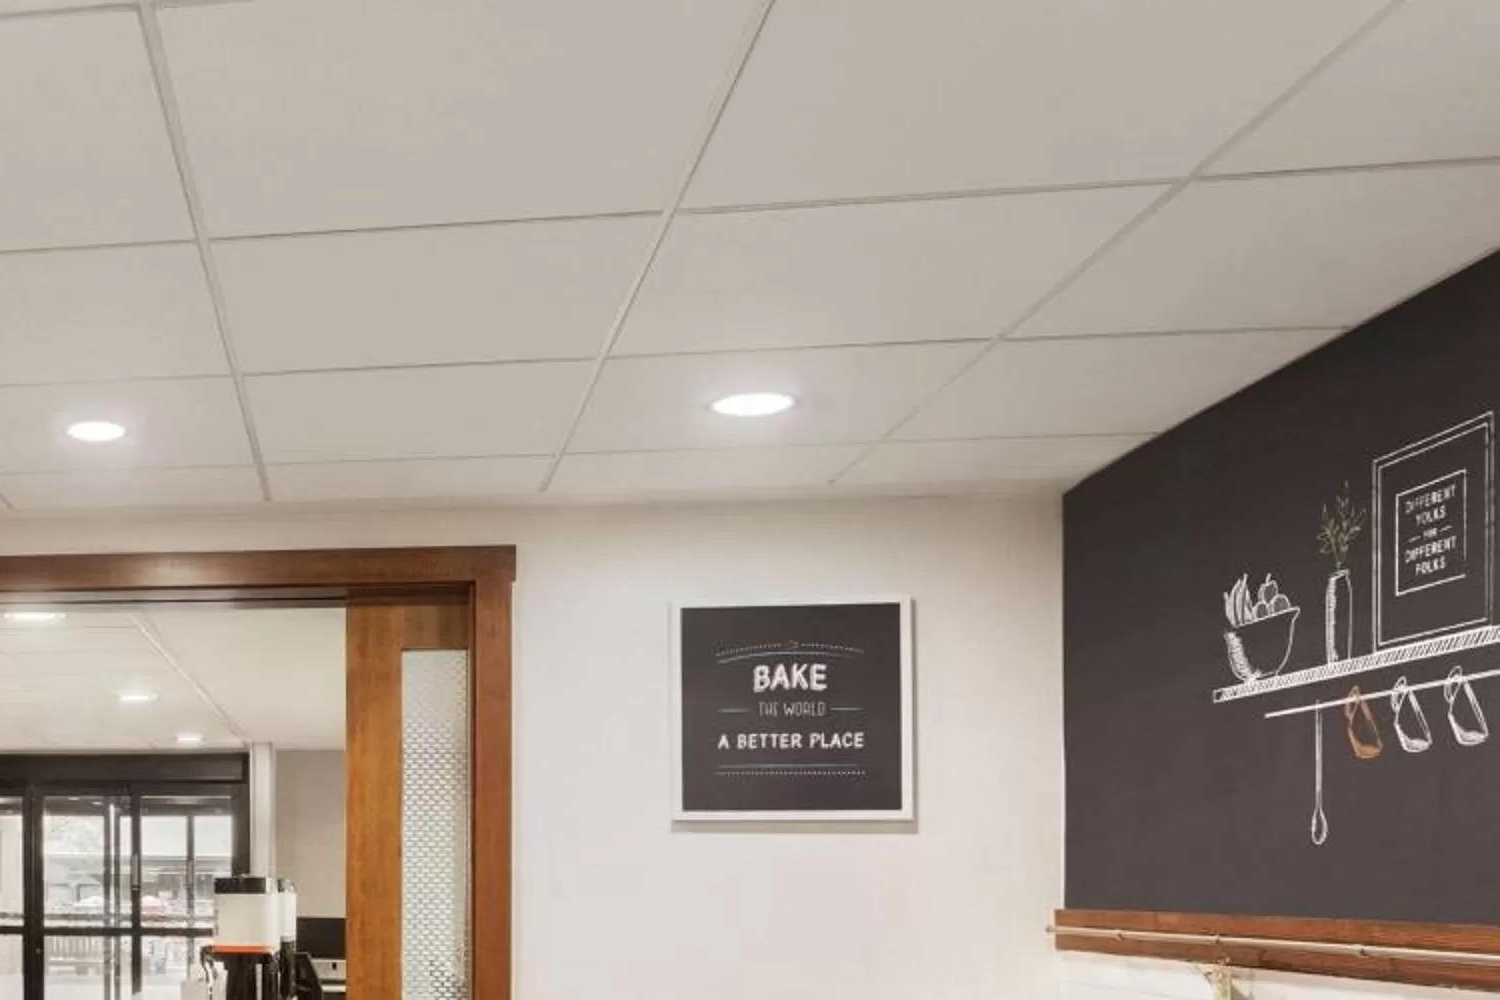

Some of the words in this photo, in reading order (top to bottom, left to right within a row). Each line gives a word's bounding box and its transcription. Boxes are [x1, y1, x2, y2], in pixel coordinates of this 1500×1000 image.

[1404, 484, 1456, 514] DIFFERENT
[1416, 504, 1446, 526] YOLKS
[1404, 536, 1457, 564] DIFFERENT
[1415, 556, 1446, 577] FOLKS
[752, 662, 828, 693] BAKE
[758, 701, 778, 717] THE
[783, 701, 827, 717] WORLD
[717, 733, 730, 749] A
[737, 733, 802, 749] BETTER
[809, 731, 865, 749] PLACE
